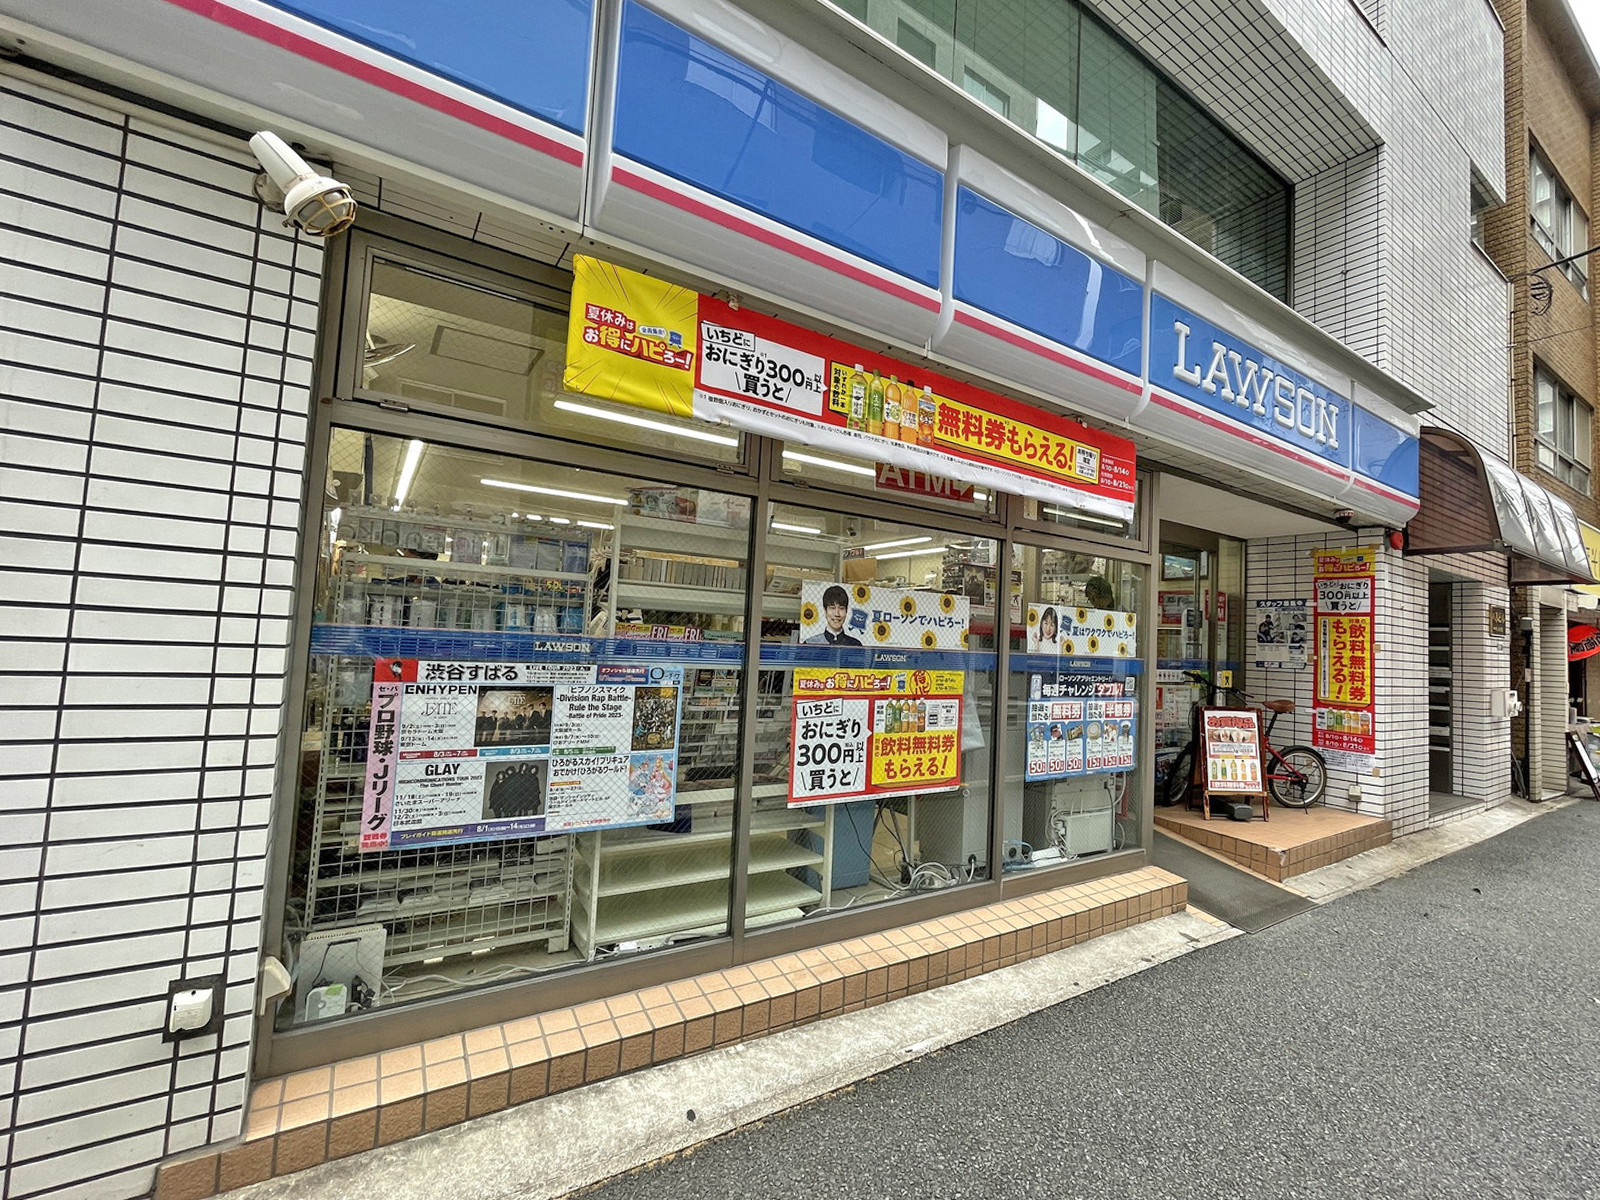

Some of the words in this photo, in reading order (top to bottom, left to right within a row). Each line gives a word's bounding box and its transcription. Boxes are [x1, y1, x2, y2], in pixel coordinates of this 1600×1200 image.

[587, 304, 635, 331] 夏休みは
[706, 326, 752, 347] いちどに
[742, 372, 785, 402] 買うと
[1172, 319, 1340, 451] LAWSON
[937, 401, 1075, 472] 無料券もらえる!
[534, 641, 592, 654] LAWSON
[1331, 618, 1348, 700] もらえる!
[424, 663, 519, 682] 渋谷すばる
[1348, 624, 1367, 701] 飲料無料券
[404, 684, 477, 695] ENHYPEN
[568, 703, 586, 711] Rule
[588, 703, 600, 711] the
[601, 703, 623, 712] Stage
[802, 701, 840, 717] いちどに
[801, 717, 862, 740] おにぎり
[796, 740, 865, 767] 300円以上
[880, 734, 956, 757] 飲料無料券
[366, 692, 399, 832] プロ野球・Jリーグ
[424, 762, 461, 777] GLAY
[551, 755, 630, 768] ひろがるスカイ!プリキュア
[552, 765, 628, 777] おでかけ!ひろがるワールド!
[884, 755, 948, 780] もらえる!
[808, 767, 852, 791] 買うと
